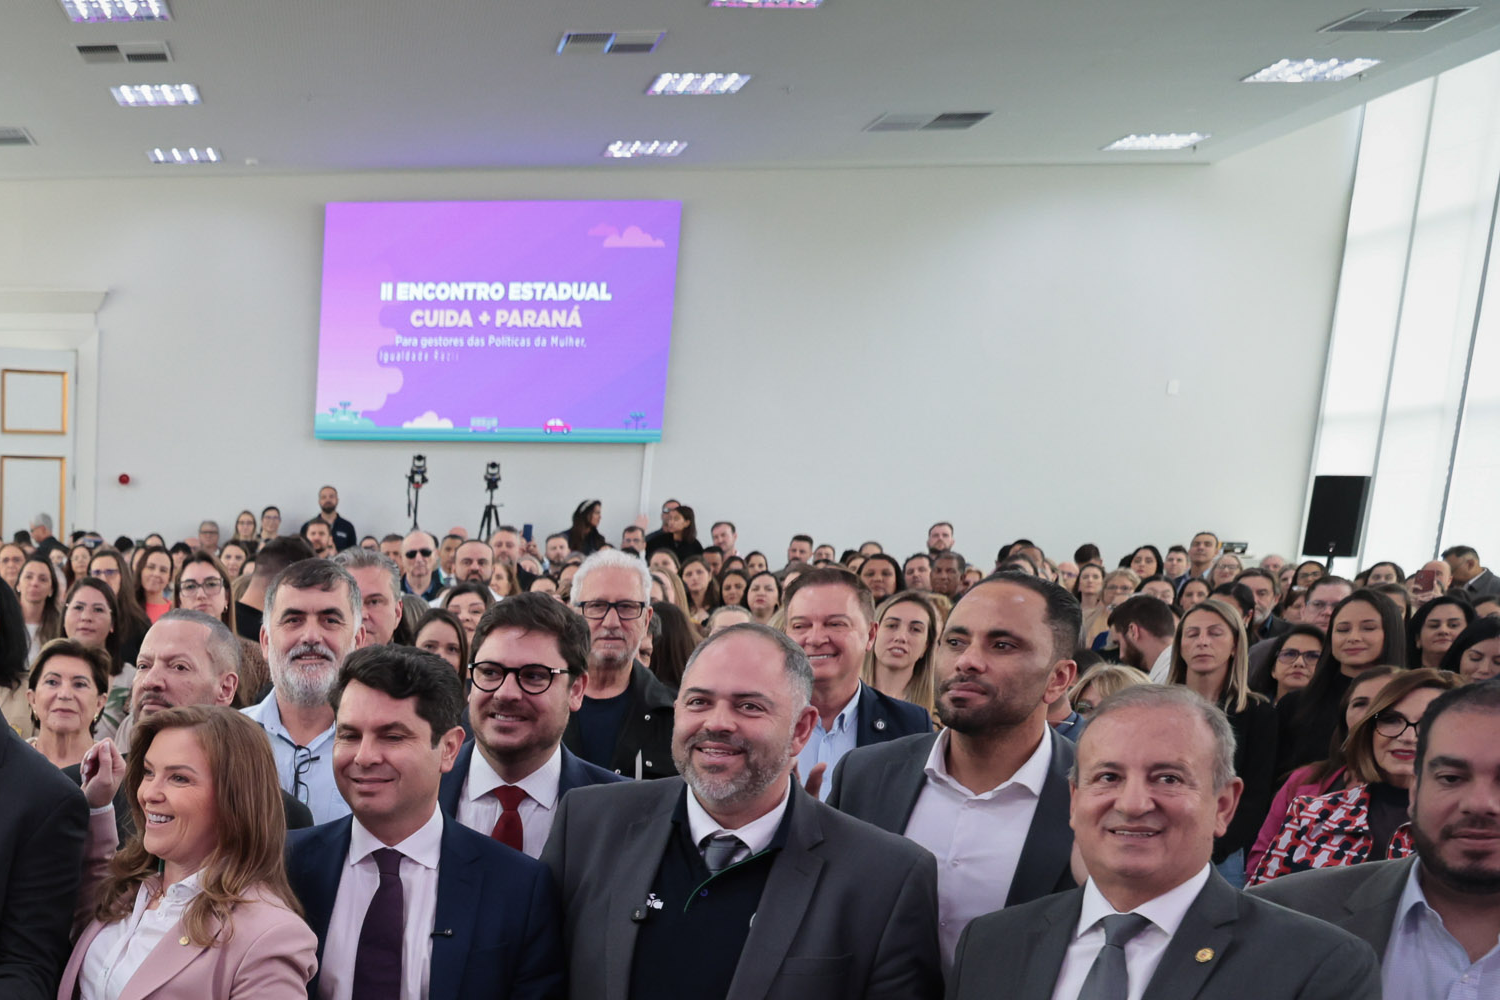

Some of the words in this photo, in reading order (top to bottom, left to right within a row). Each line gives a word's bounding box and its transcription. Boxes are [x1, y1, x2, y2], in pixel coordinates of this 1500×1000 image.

[380, 282, 393, 301] II
[397, 282, 505, 301] ENCONTRO
[508, 282, 612, 302] ESTADUAL
[410, 309, 473, 328] CUIDA
[479, 313, 491, 326] +
[495, 305, 582, 328] PARANÁ
[395, 335, 418, 348] Para
[420, 336, 465, 350] gestores
[467, 335, 486, 348] das
[488, 335, 532, 348] Políticas
[534, 336, 547, 348] da
[550, 336, 587, 349] Mulher,
[379, 351, 430, 363] Igualdade
